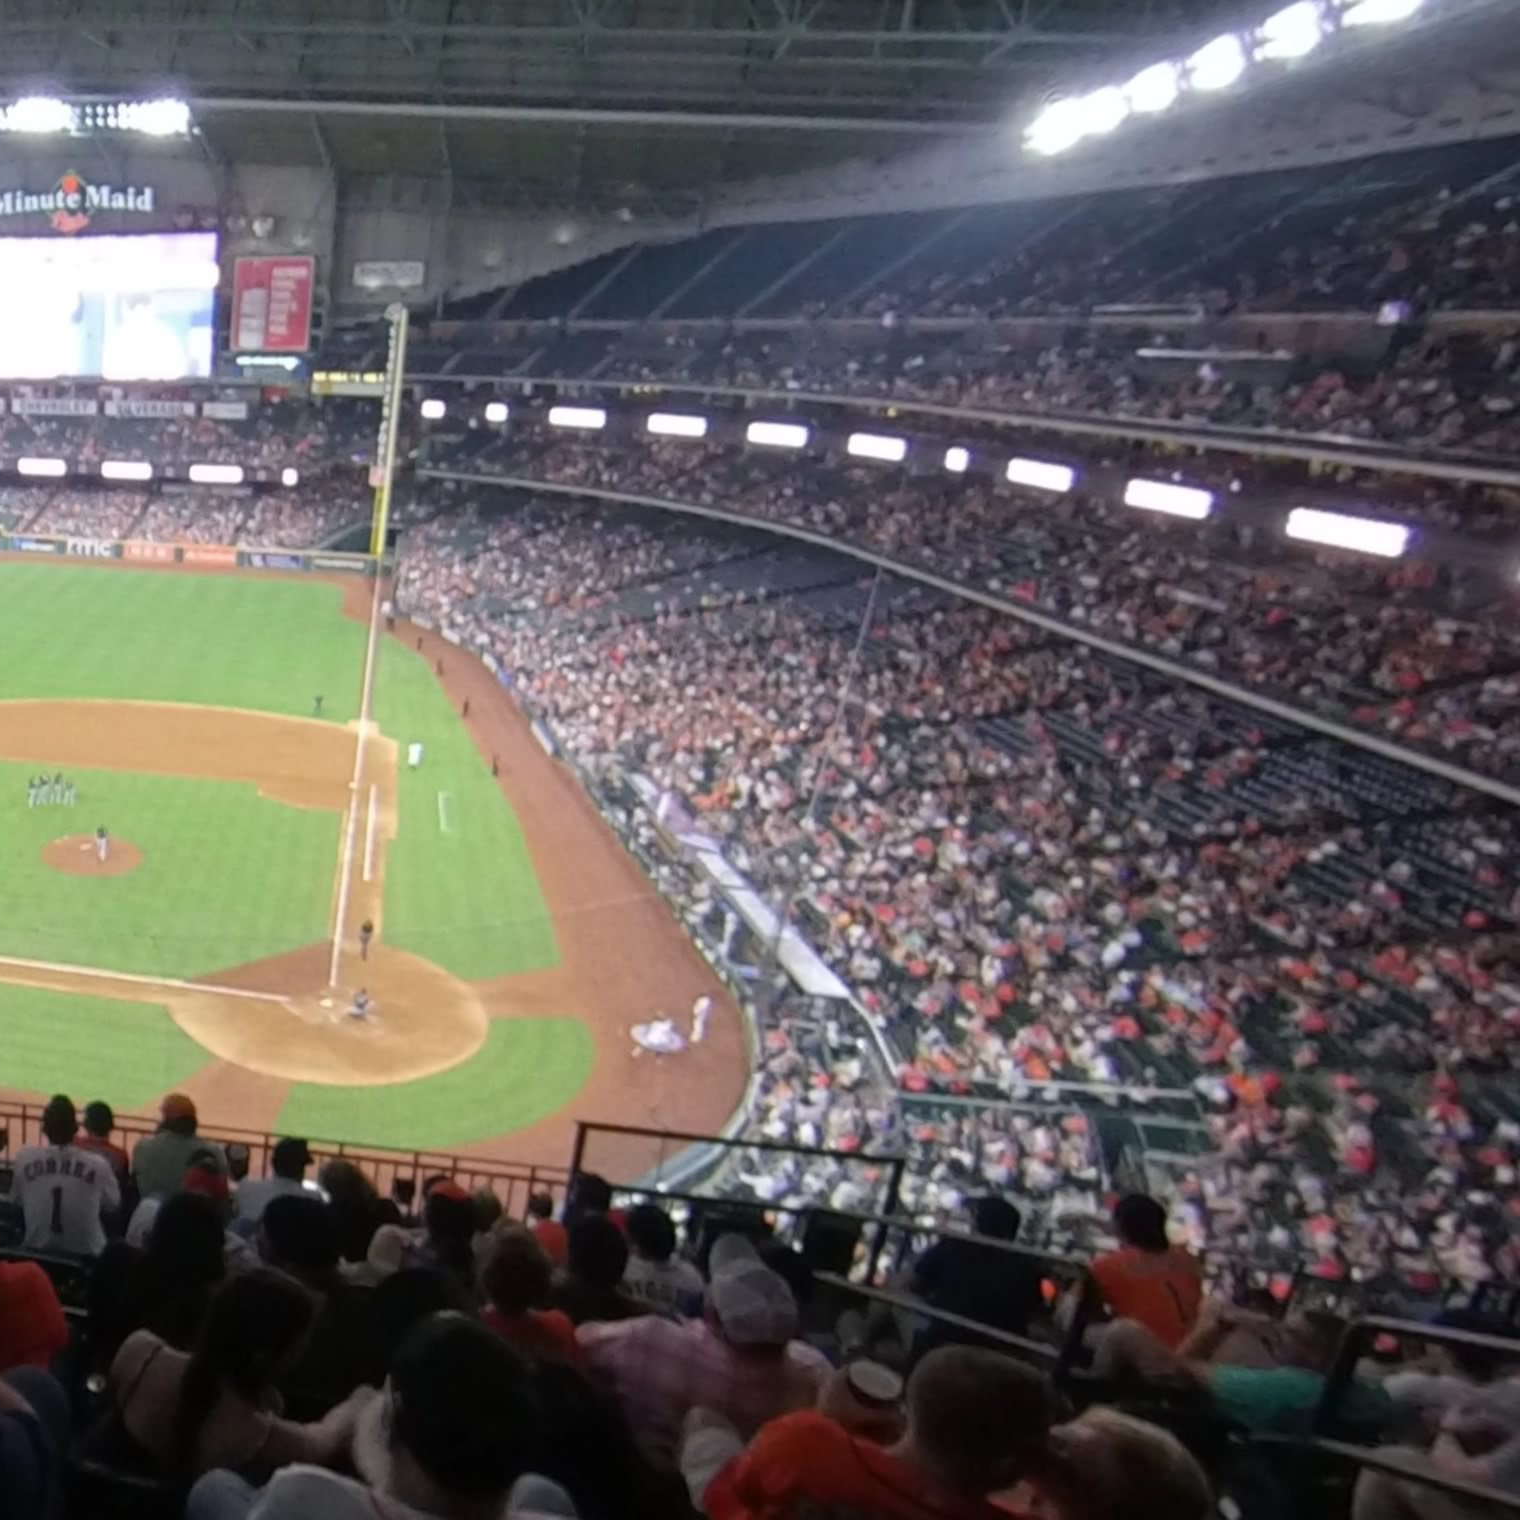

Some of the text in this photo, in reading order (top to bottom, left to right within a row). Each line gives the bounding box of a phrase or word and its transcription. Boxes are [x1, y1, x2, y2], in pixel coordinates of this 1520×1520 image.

[84, 185, 153, 212] Maid
[23, 1154, 97, 1186] CORREA
[50, 1186, 63, 1235] 1
